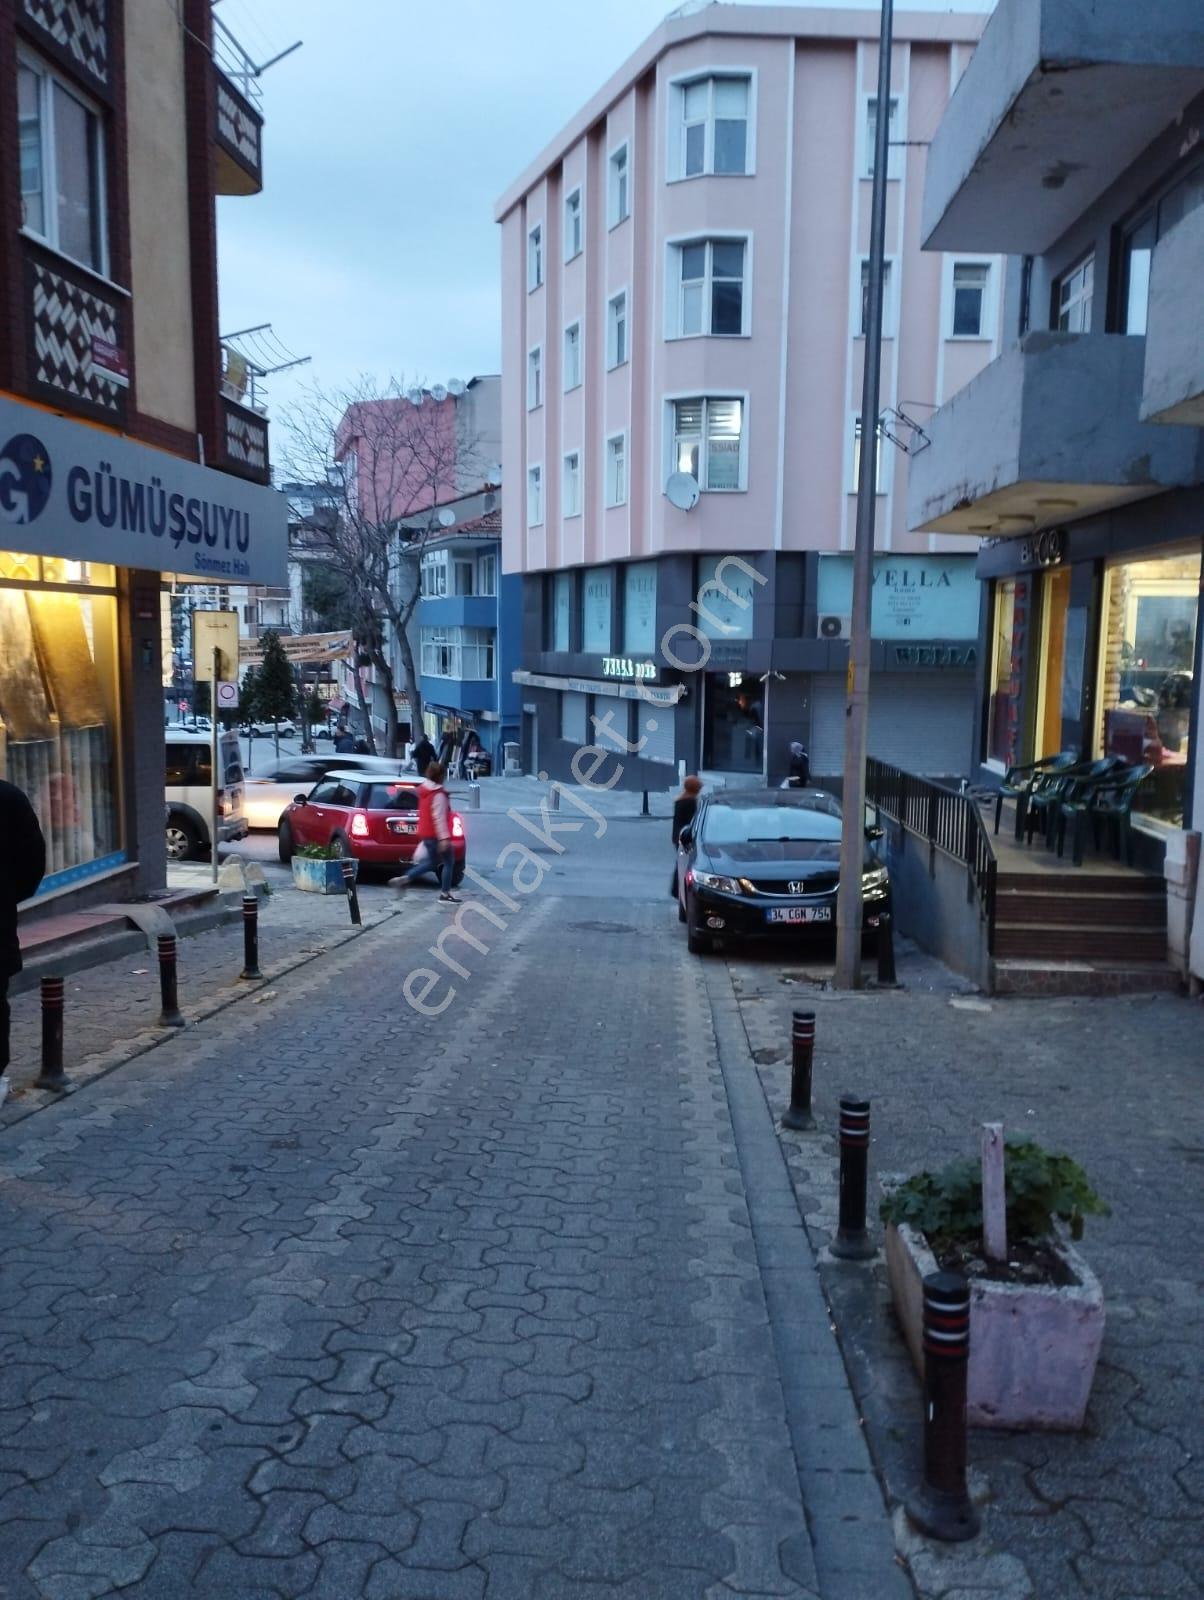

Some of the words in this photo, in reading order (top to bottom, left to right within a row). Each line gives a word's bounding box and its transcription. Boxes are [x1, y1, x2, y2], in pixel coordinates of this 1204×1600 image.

[67, 461, 250, 553] GÜMÜŞSUYU
[194, 551, 231, 574] Sönmez
[896, 646, 976, 665] WELLA
[773, 908, 783, 920] 34
[811, 908, 829, 920] 754
